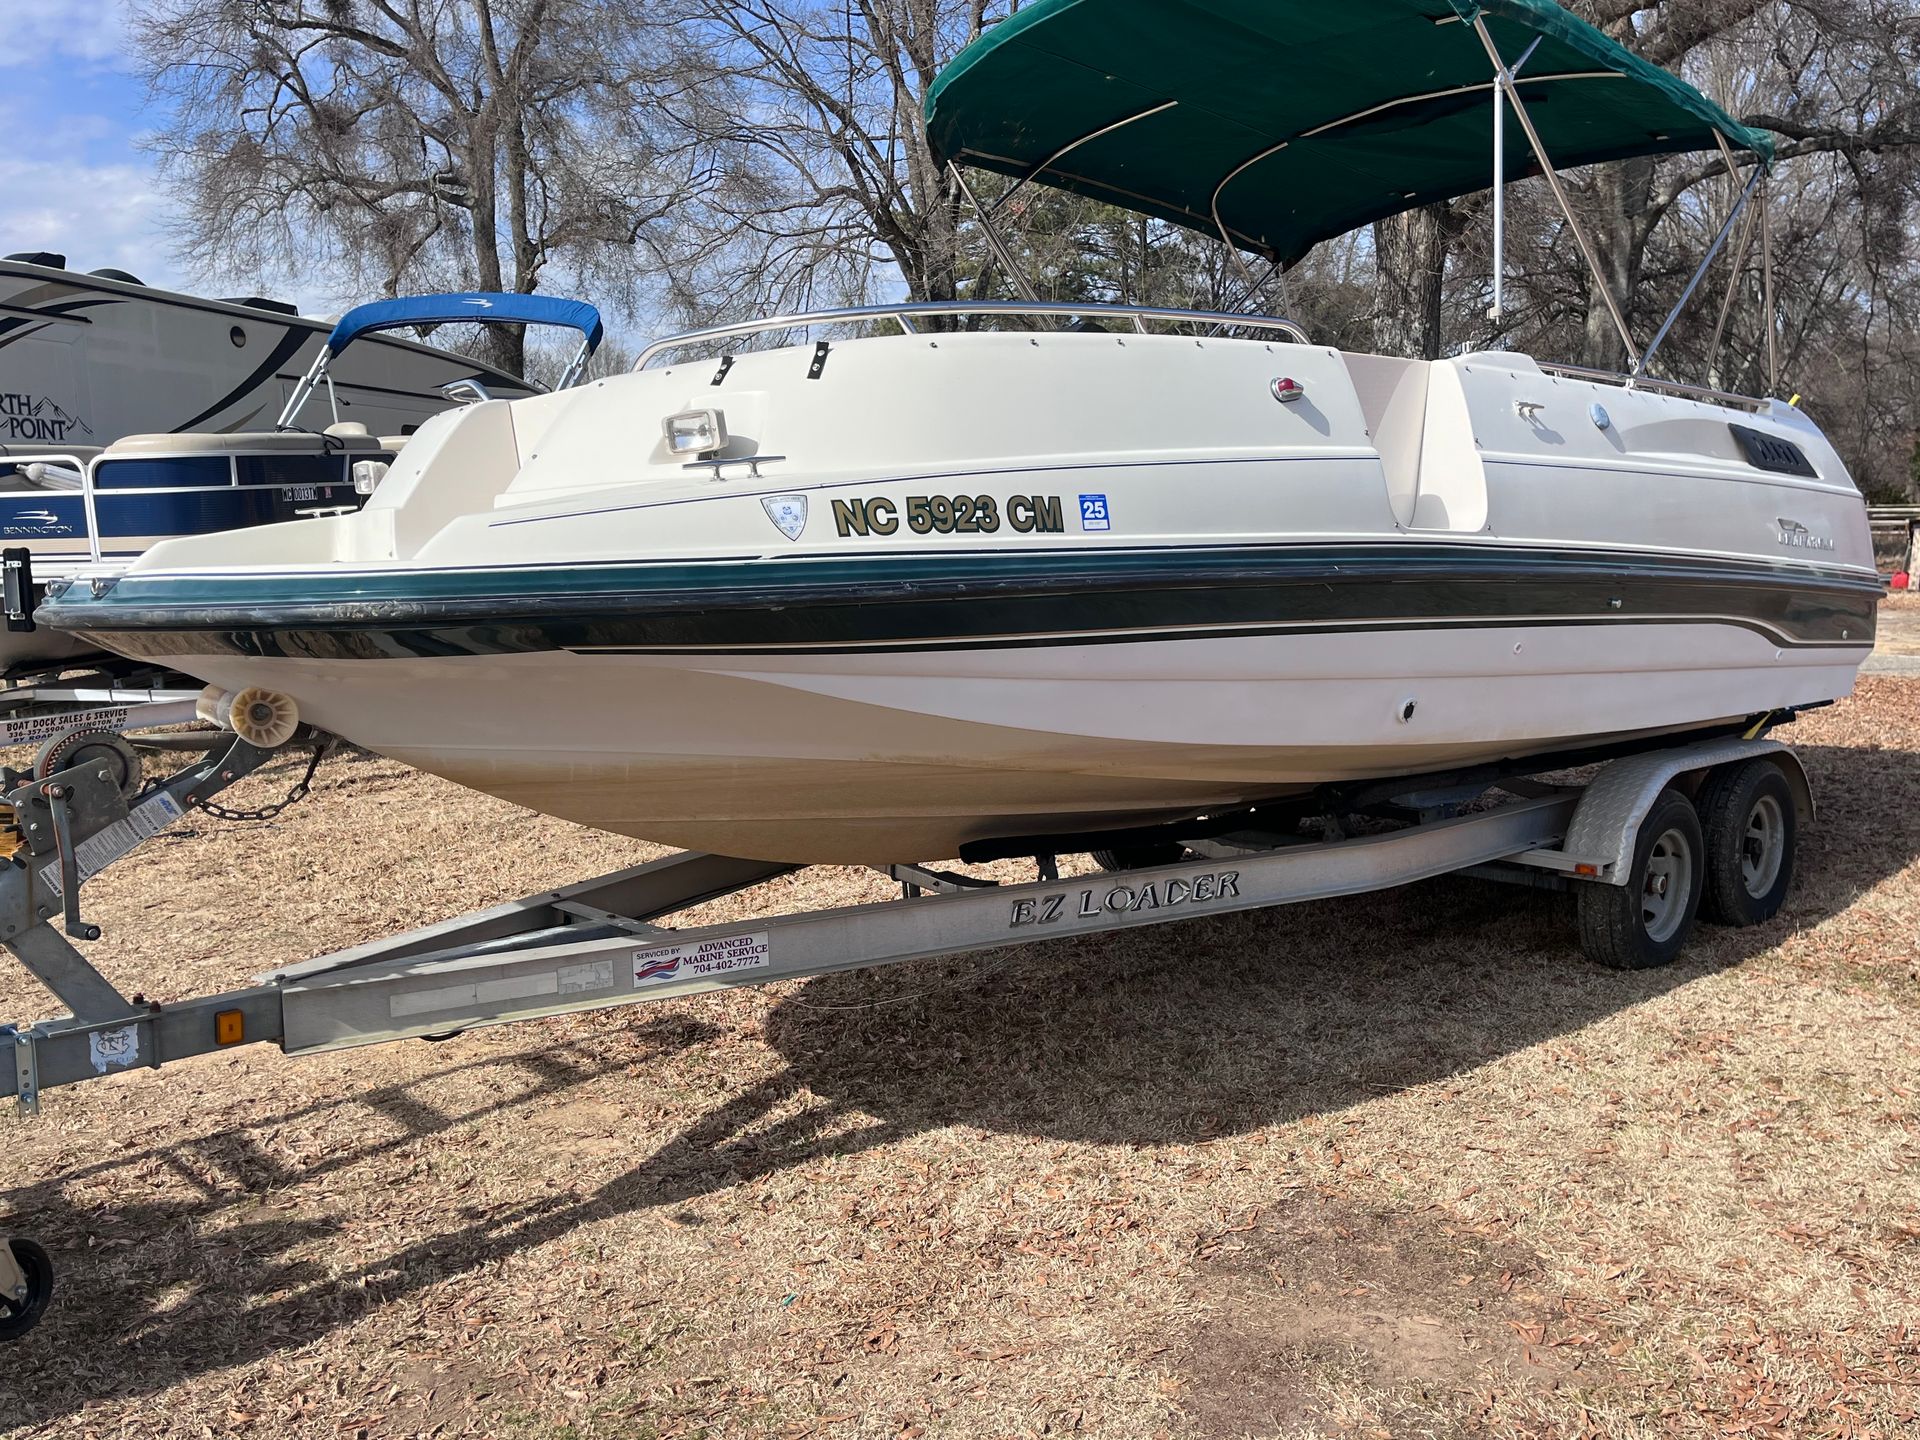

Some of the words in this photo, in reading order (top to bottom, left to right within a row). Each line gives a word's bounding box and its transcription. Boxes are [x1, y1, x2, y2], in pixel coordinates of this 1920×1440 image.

[8, 416, 66, 441] POINT
[831, 497, 899, 537] NC
[906, 495, 1000, 535] 5923
[1007, 494, 1064, 533] CM
[1083, 501, 1106, 519] 25
[3, 525, 72, 534] BENNINGTON
[6, 722, 30, 732] BOAT
[33, 717, 57, 728] DOCK
[58, 713, 84, 725] SALES
[86, 713, 92, 721] &
[94, 708, 128, 720] SERVICE
[8, 725, 65, 739] 336-357-5906
[1009, 894, 1066, 928] EZ
[1078, 871, 1241, 918] LOADER
[636, 948, 671, 960] SERVICED
[671, 947, 681, 955] BY
[683, 950, 725, 966] MARINE
[727, 944, 768, 959] SERVICE
[697, 937, 753, 954] ADVANCED
[693, 955, 760, 974] 704-402-7772
